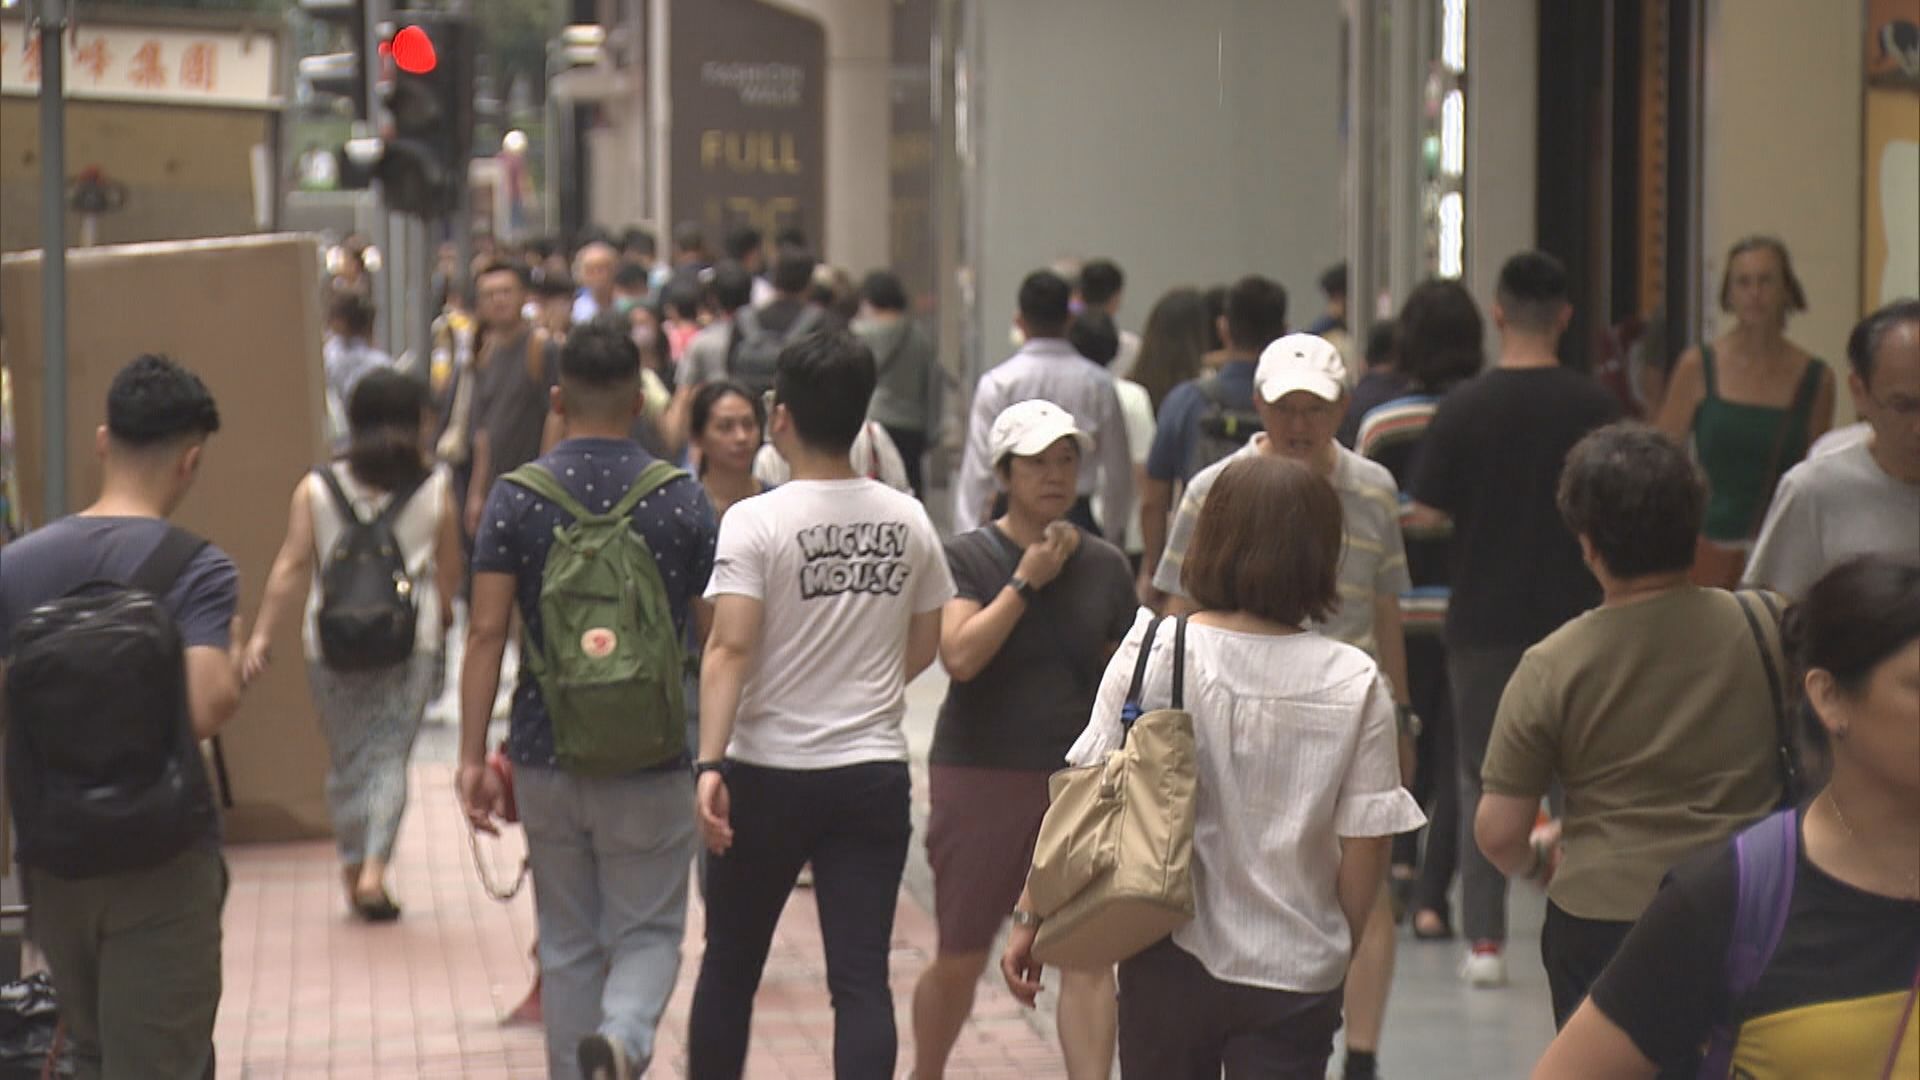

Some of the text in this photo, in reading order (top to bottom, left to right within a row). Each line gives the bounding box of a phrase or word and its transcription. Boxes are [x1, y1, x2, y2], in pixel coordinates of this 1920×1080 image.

[701, 129, 800, 174] FULL
[797, 522, 908, 562] MICKEY
[800, 561, 911, 600] MOUSE
